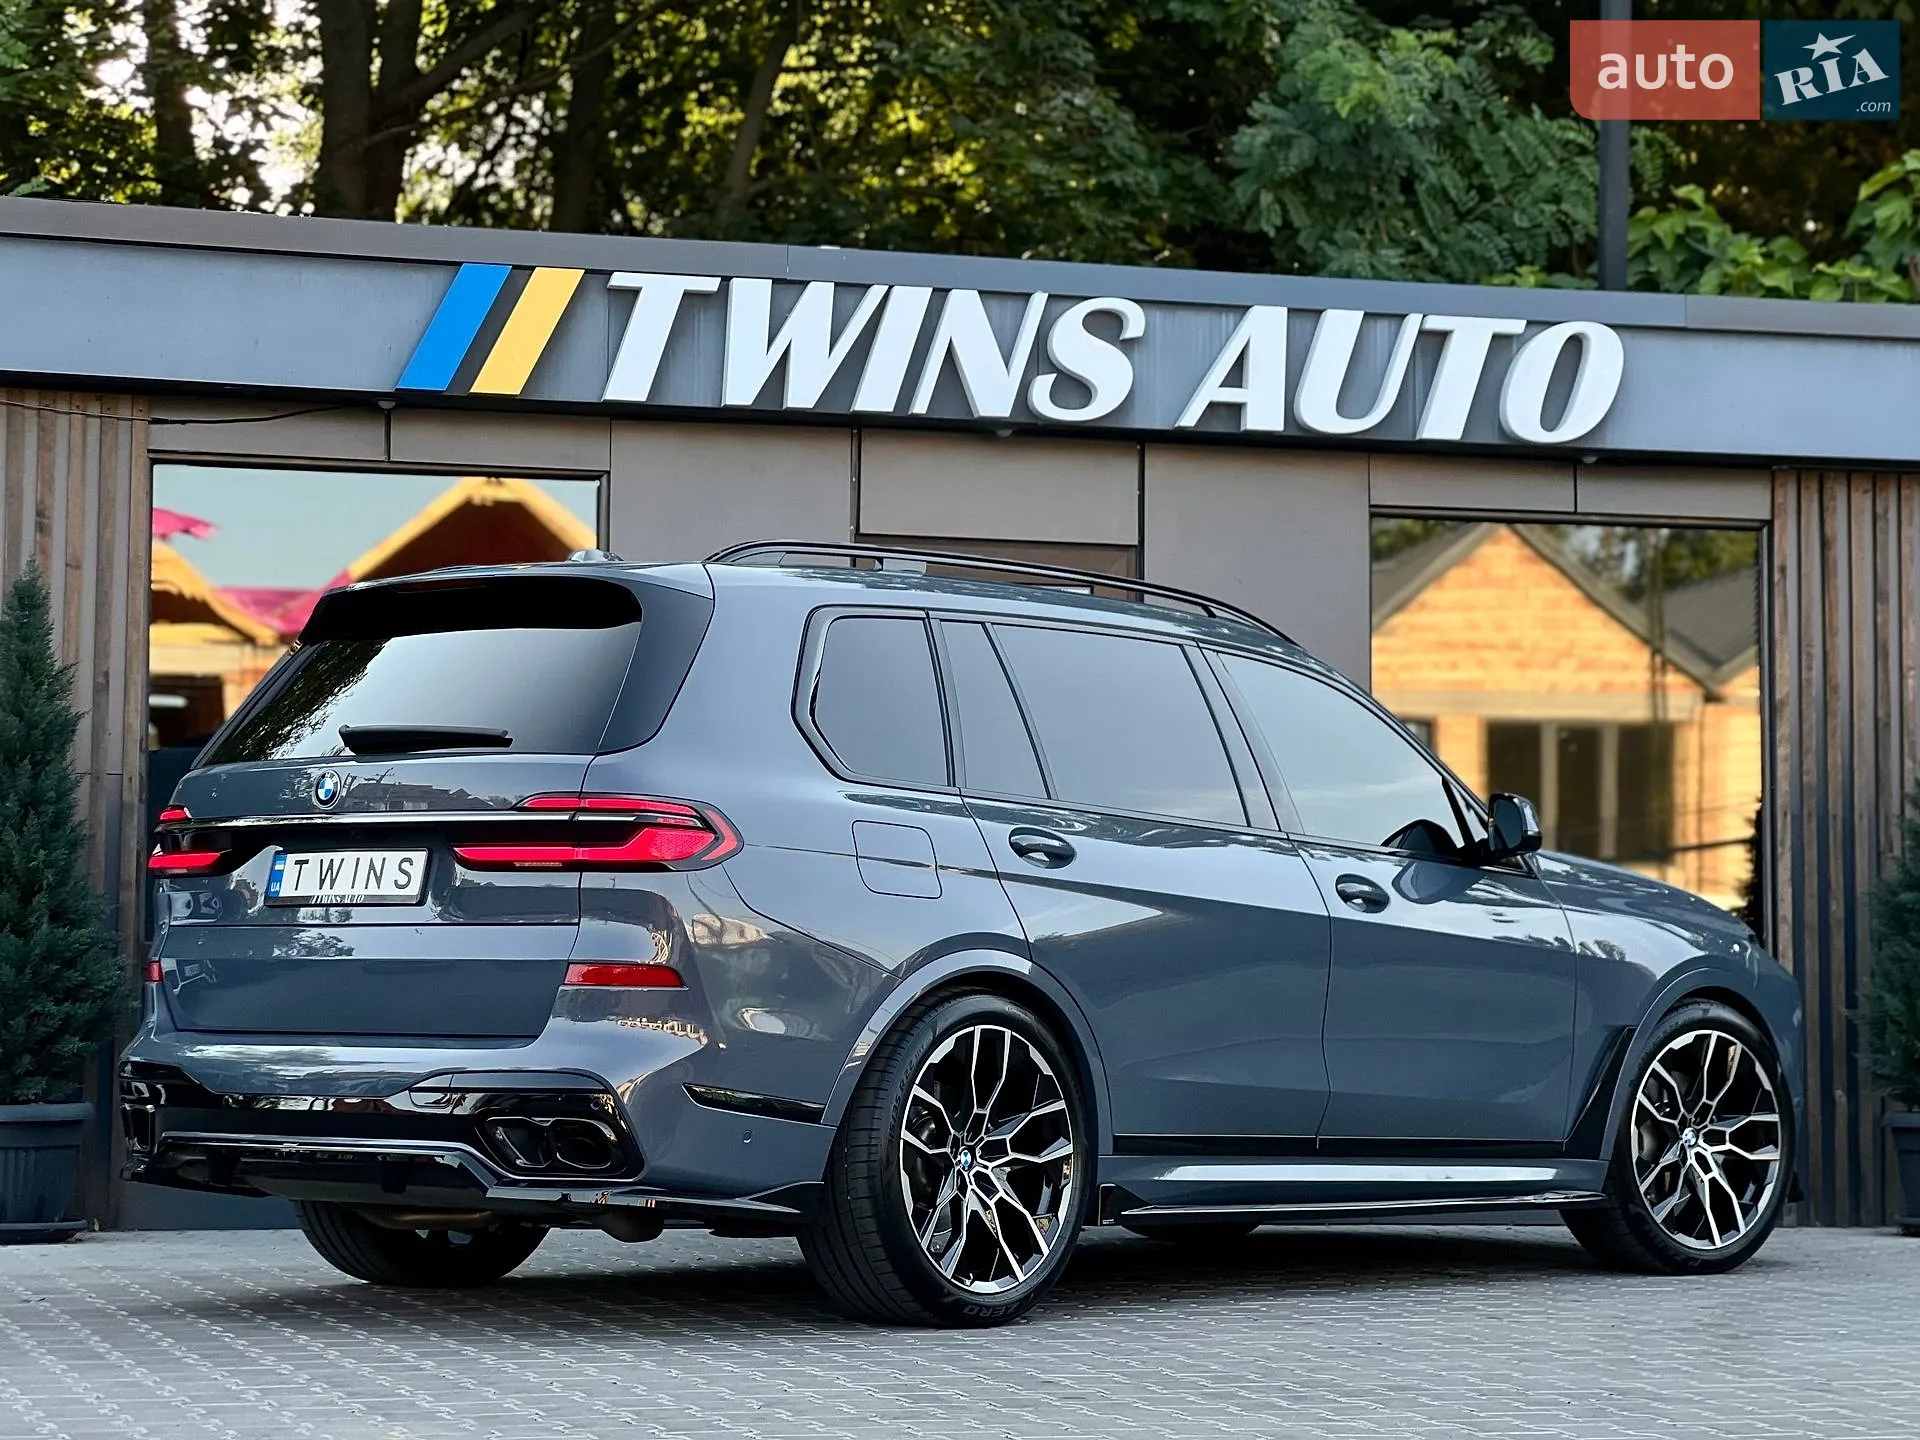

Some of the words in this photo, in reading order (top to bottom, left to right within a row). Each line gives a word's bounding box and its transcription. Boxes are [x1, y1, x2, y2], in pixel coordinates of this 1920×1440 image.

[601, 271, 1145, 421] TWINS
[1173, 305, 1625, 444] AUTO
[270, 881, 281, 892] UA
[294, 857, 414, 891] TWINS
